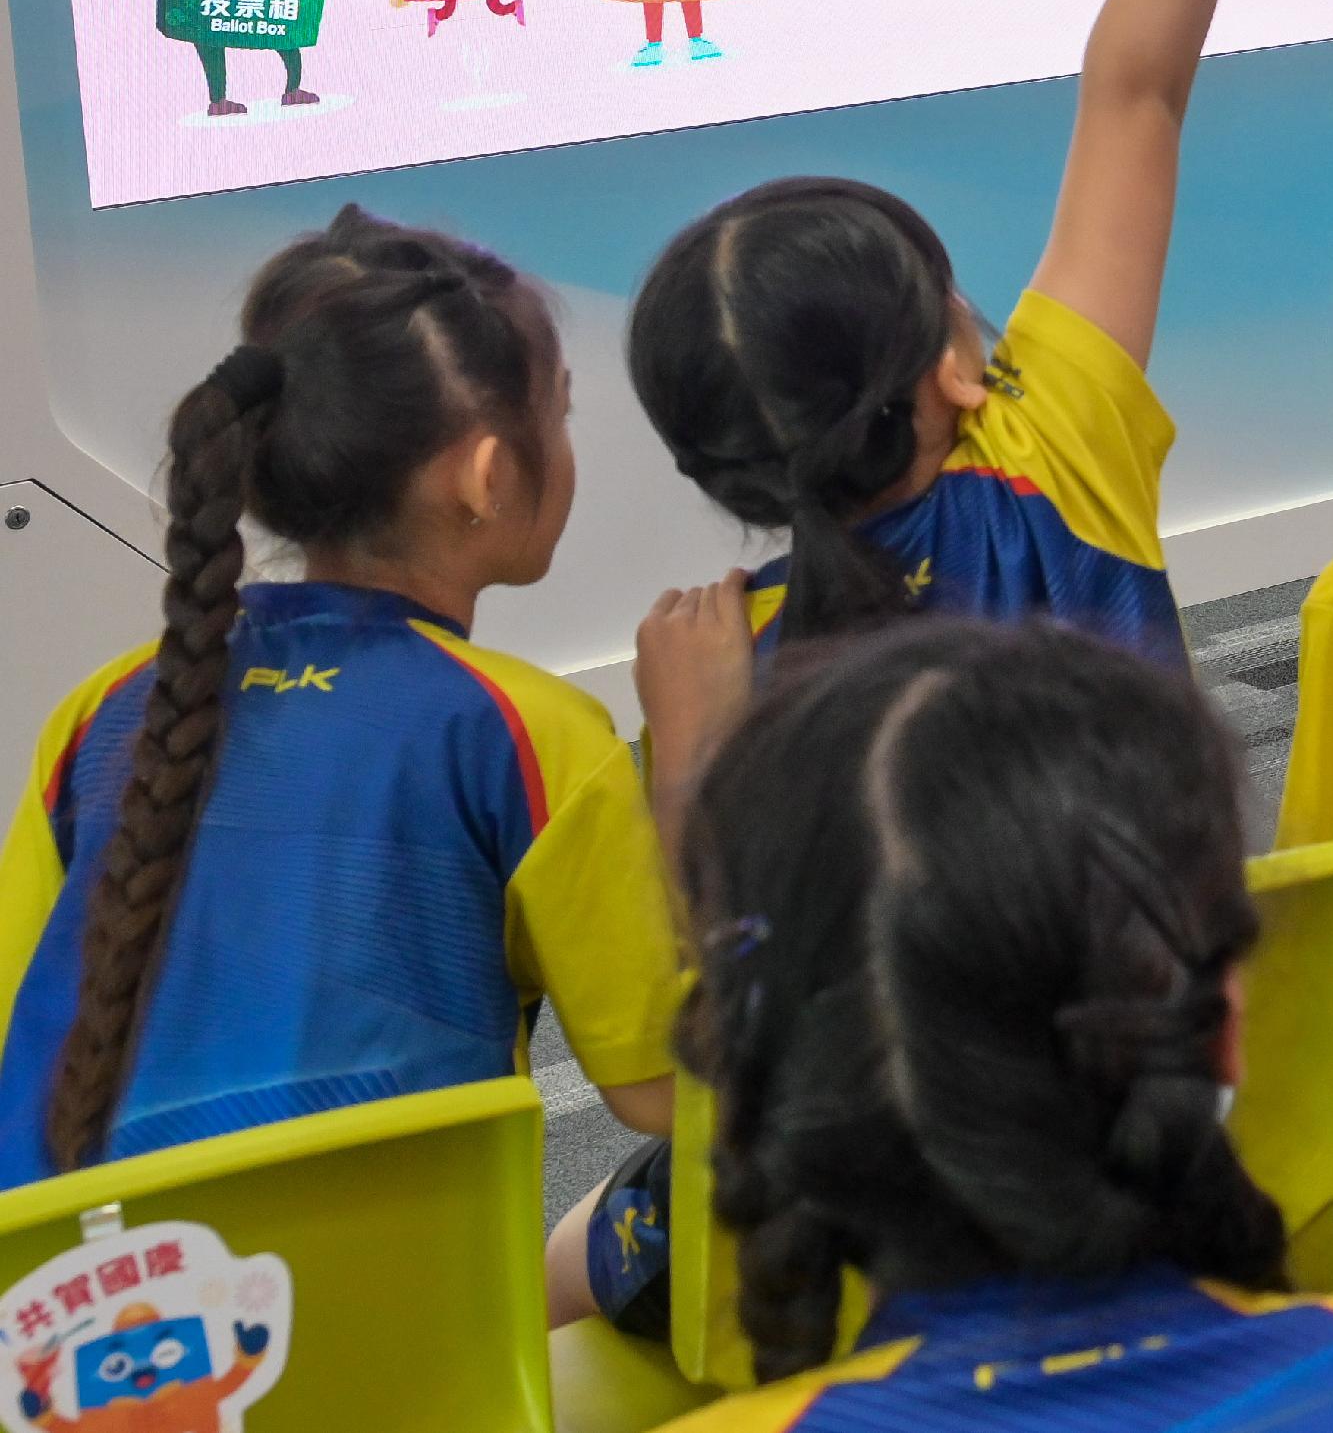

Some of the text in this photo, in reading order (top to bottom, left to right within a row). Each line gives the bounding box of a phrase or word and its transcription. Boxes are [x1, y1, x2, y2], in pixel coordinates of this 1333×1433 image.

[210, 18, 286, 36] Ballot Box
[240, 664, 341, 693] PLK
